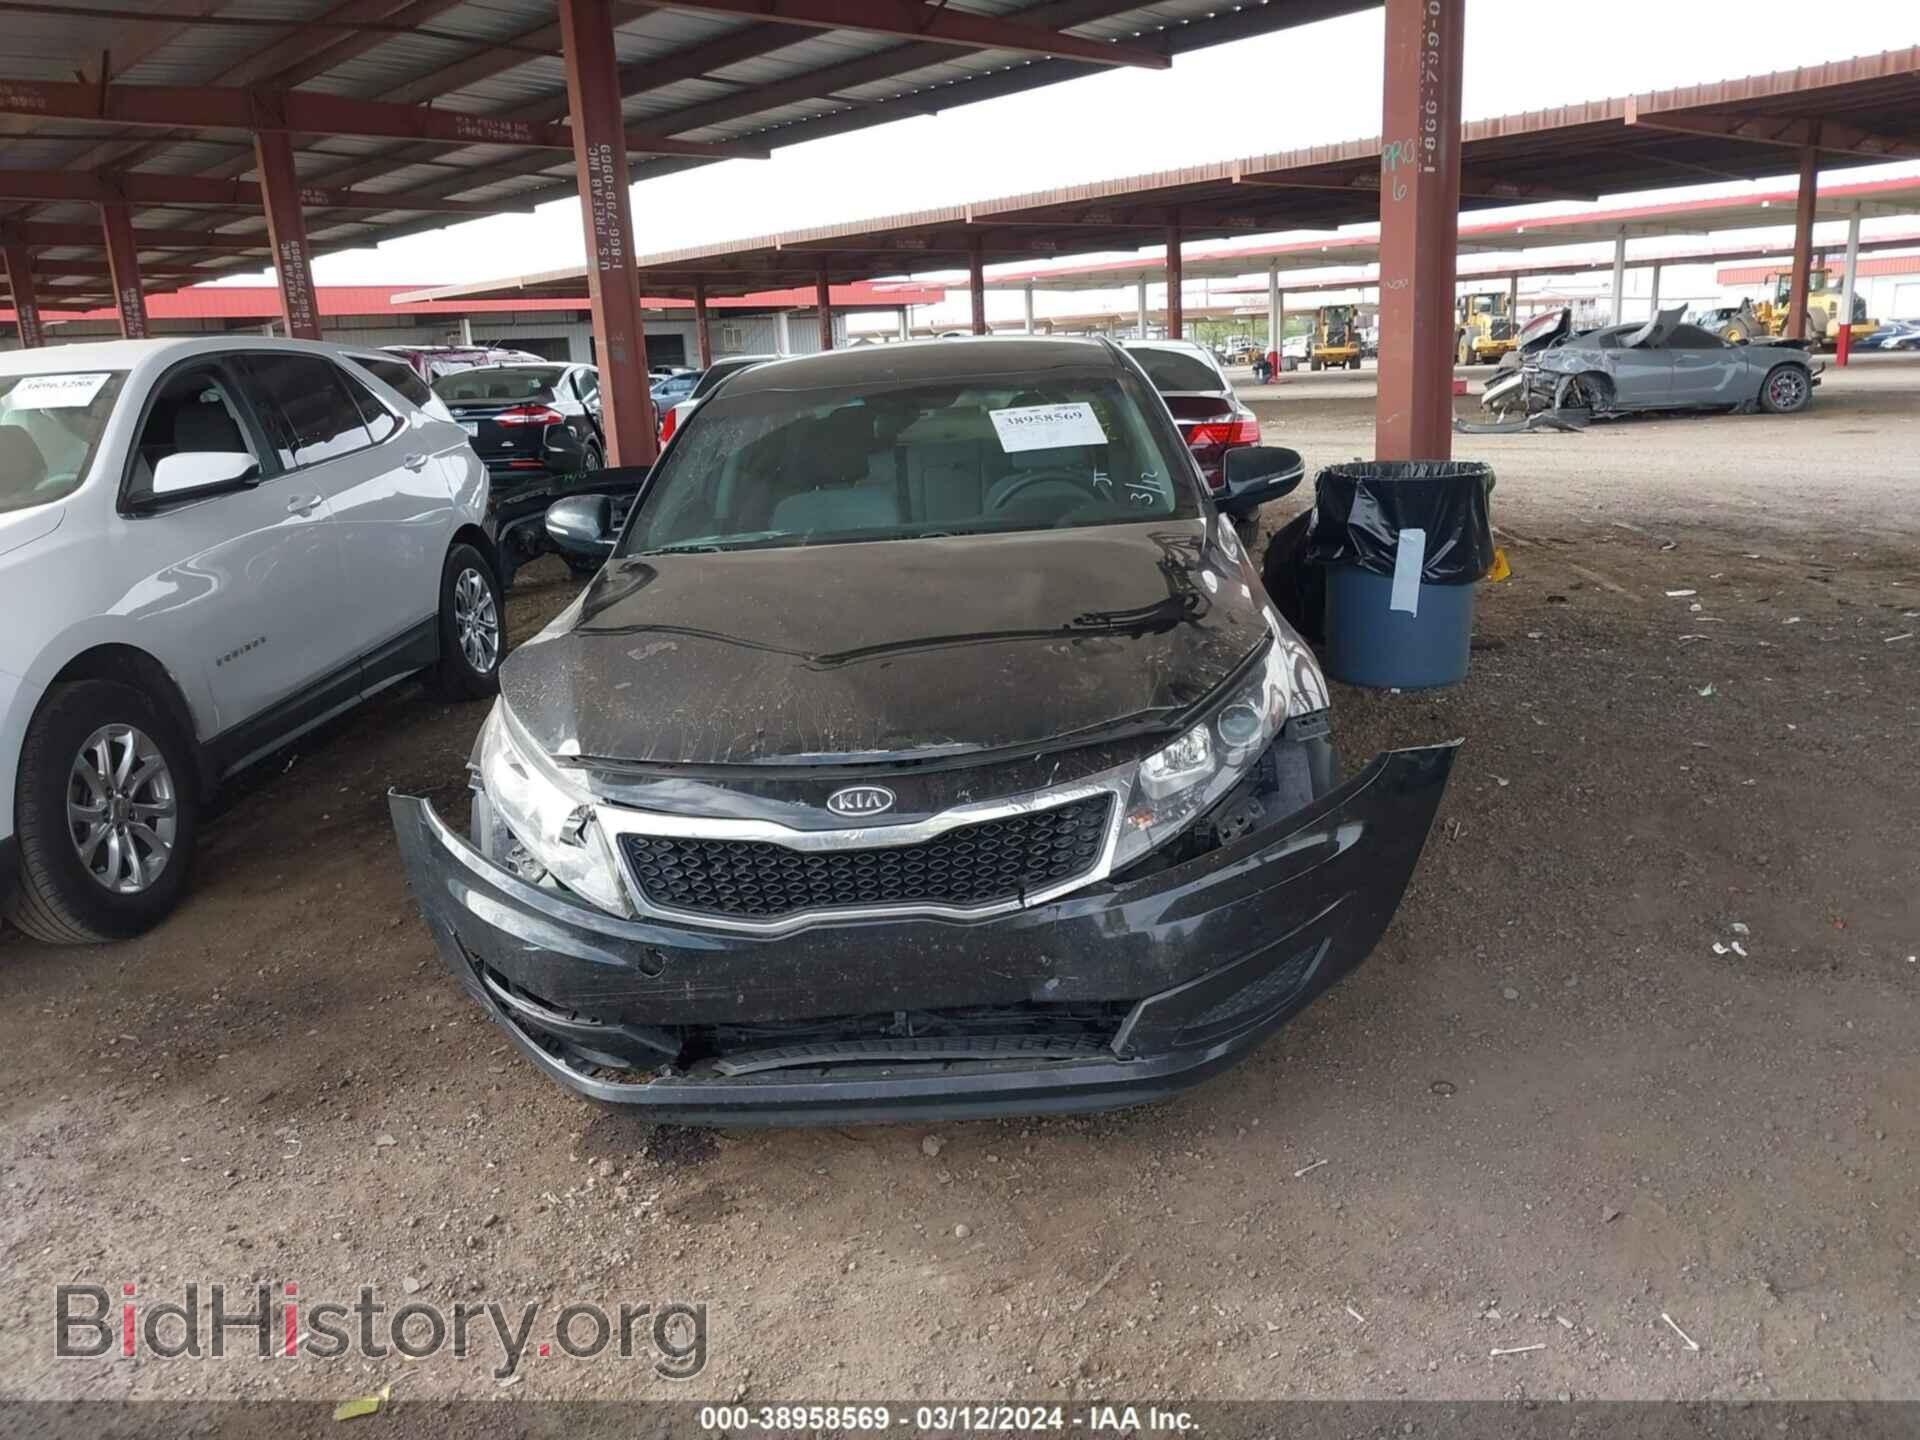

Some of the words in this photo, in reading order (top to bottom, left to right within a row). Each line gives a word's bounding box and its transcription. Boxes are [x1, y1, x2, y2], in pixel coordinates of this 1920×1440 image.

[588, 143, 601, 171] INC.
[1392, 175, 1408, 201] 6
[591, 178, 607, 235] PREFAB
[600, 143, 623, 270] 1-866-799-0969
[598, 243, 611, 271] U.S.
[1007, 410, 1083, 425] 38958569
[1123, 471, 1167, 504] 3/12
[838, 791, 882, 810] KIA
